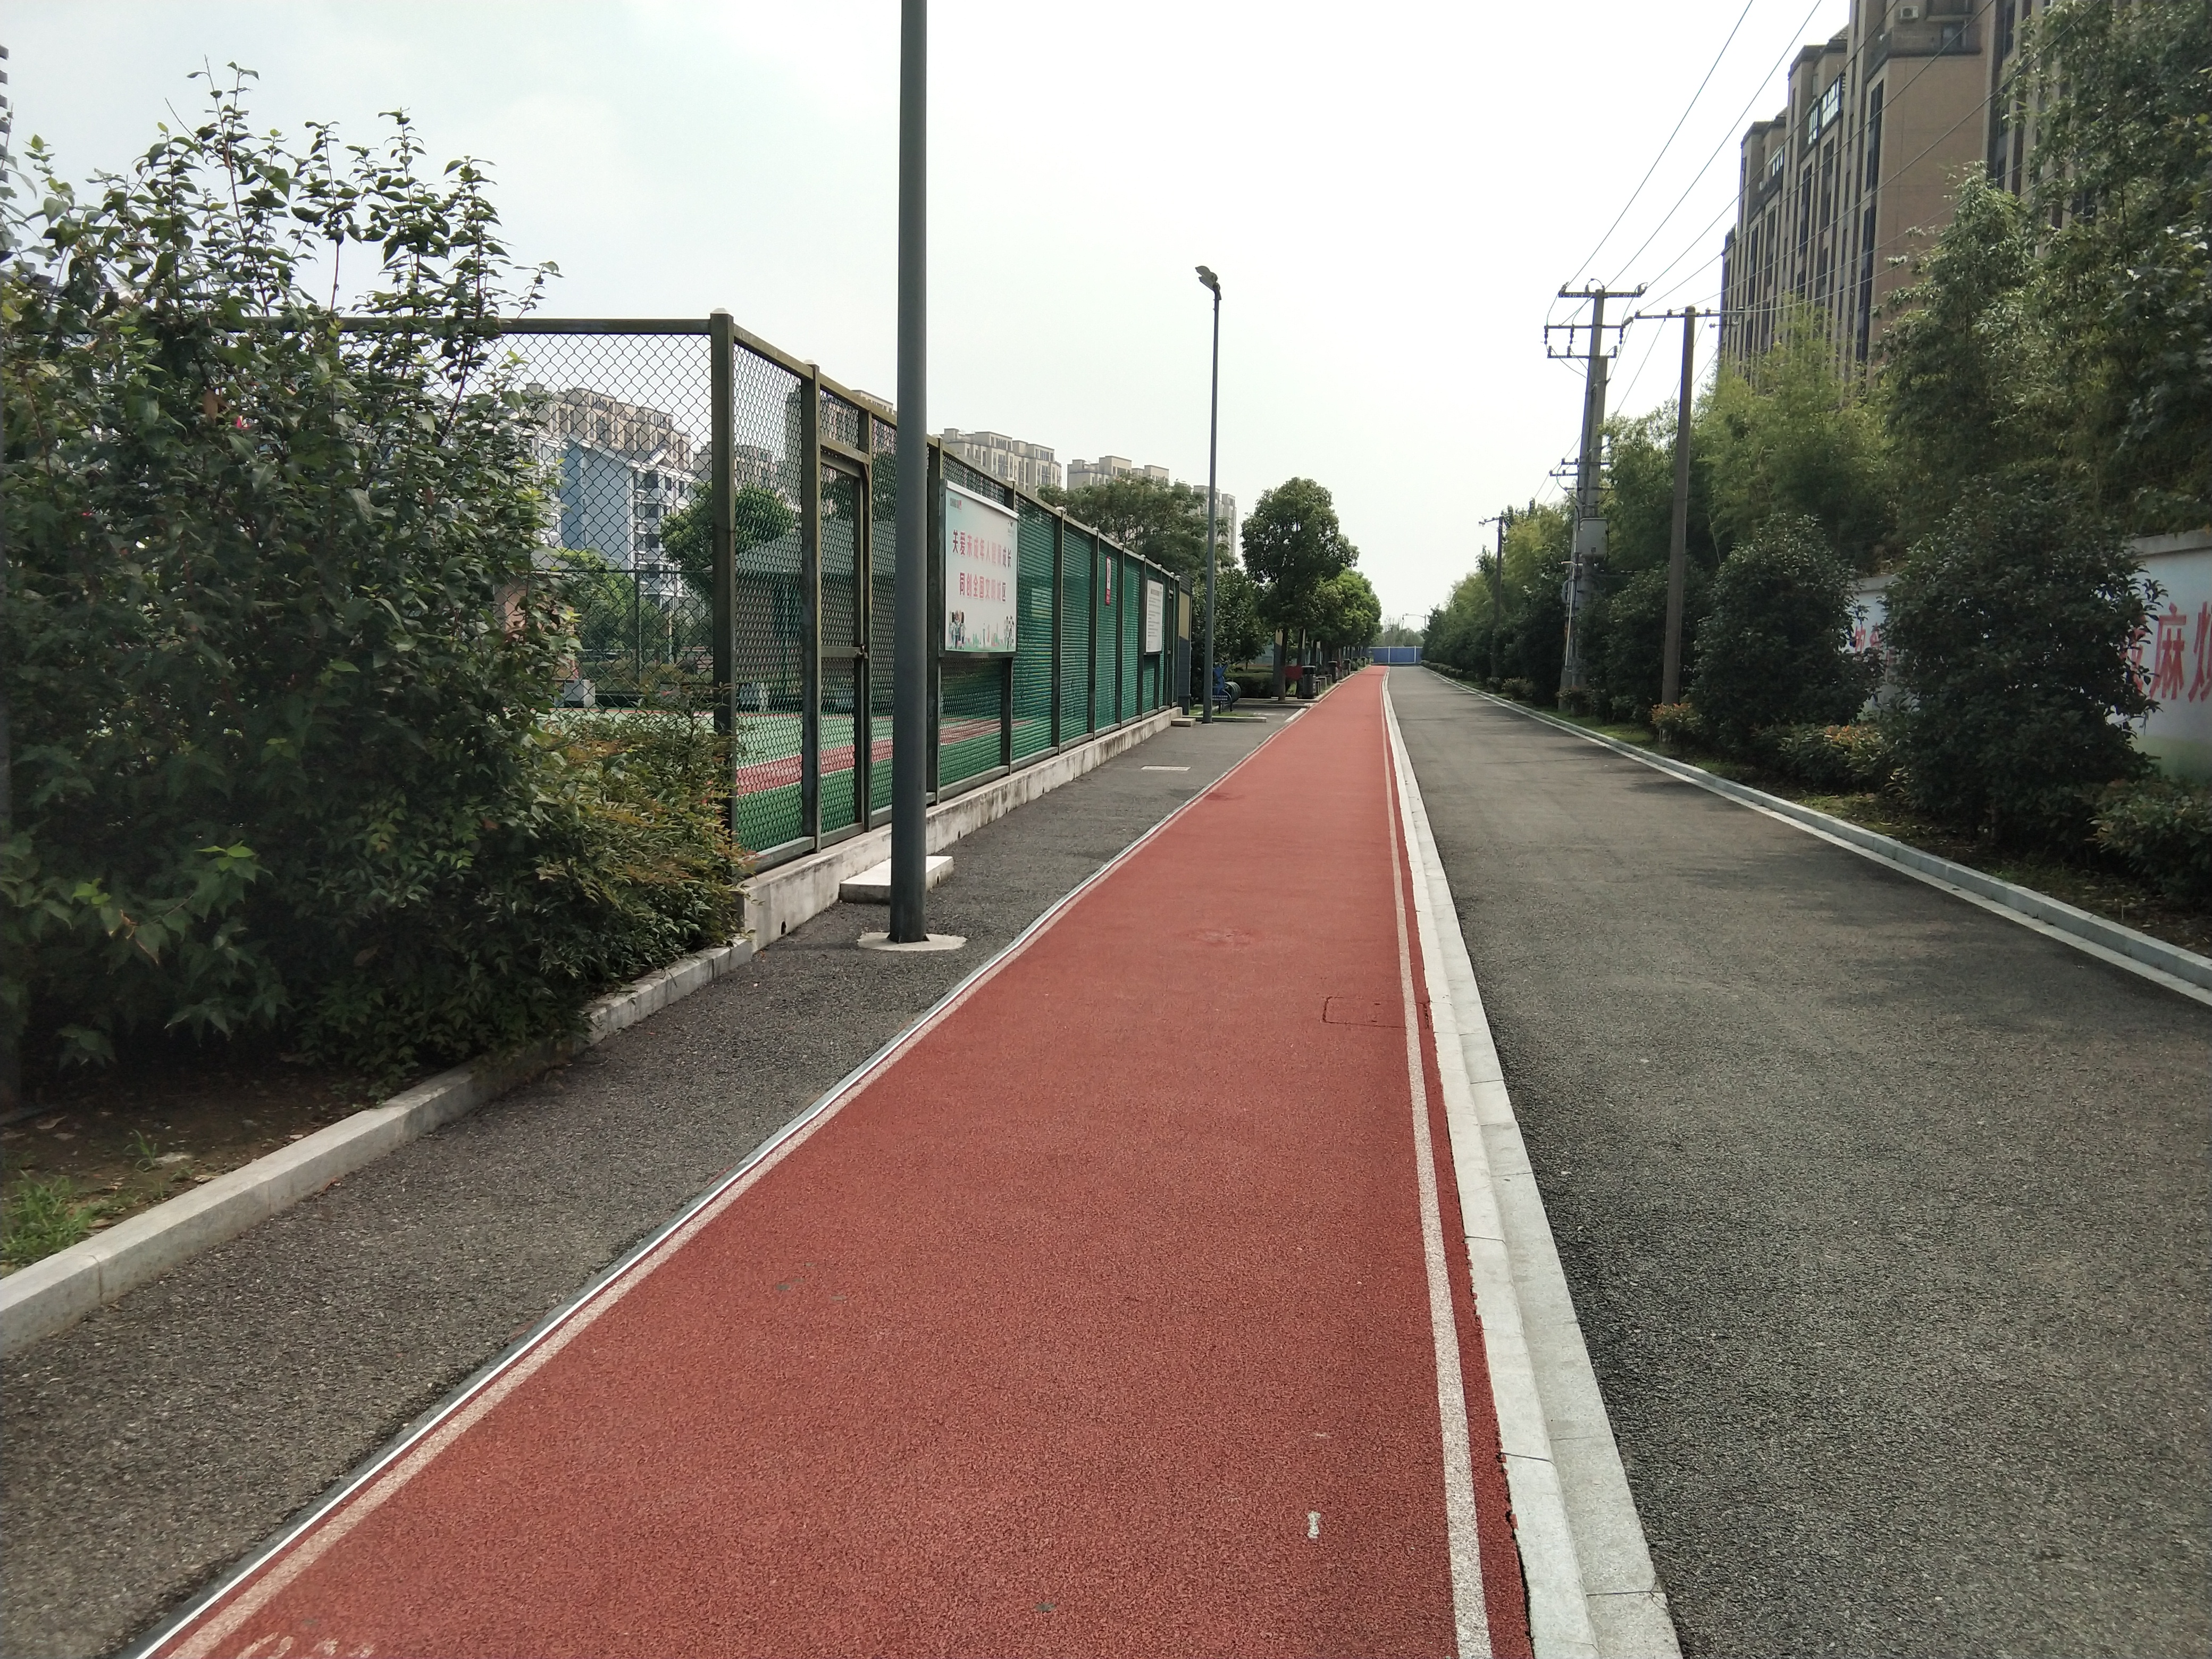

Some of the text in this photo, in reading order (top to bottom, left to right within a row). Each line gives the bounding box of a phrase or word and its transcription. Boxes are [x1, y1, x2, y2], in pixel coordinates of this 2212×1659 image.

[960, 572, 1006, 602] 同创全国文明城区
